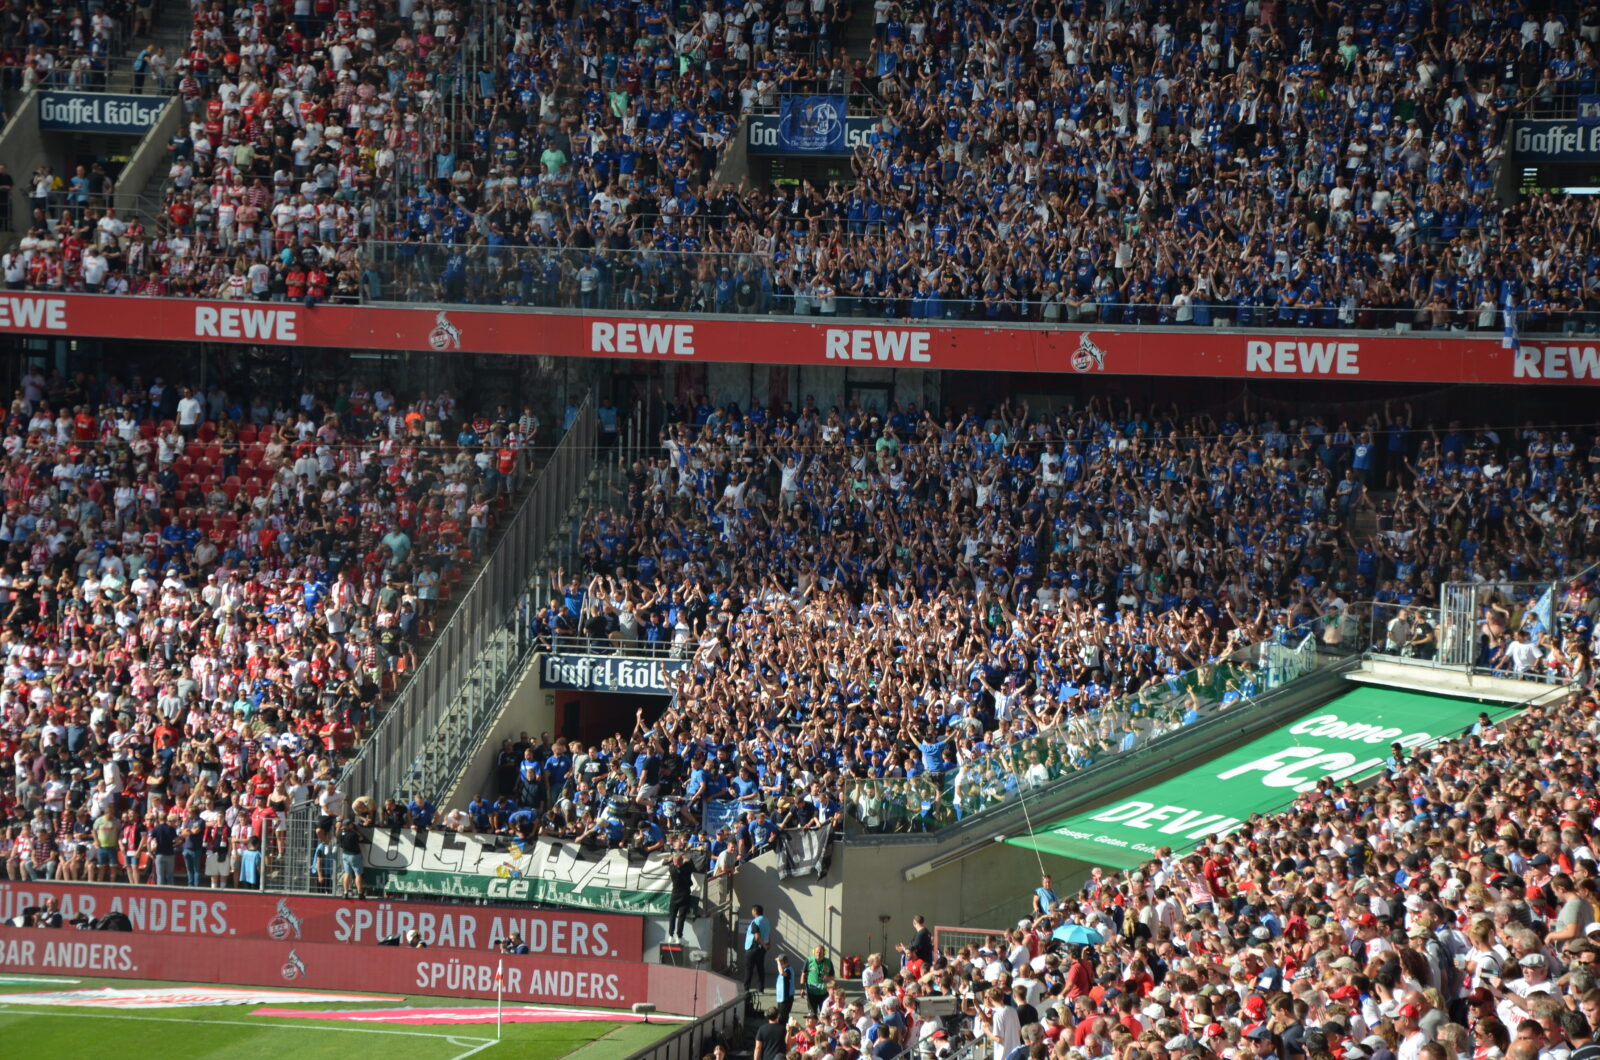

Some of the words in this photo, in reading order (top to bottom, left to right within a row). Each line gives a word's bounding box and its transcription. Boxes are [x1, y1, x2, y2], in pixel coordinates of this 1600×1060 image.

[41, 97, 101, 124] Gaffel
[1515, 126, 1586, 154] Gaffel
[195, 306, 297, 341] REWE
[591, 321, 694, 355] REWE
[826, 329, 931, 362] REWE
[1246, 341, 1359, 375] REWE
[545, 656, 612, 688] Gaffel
[1289, 714, 1402, 744] Come
[368, 827, 674, 893] ULTRAS
[334, 903, 476, 949] SPÜRBAR
[488, 917, 618, 957] ANDERS.
[42, 941, 138, 971] ANDERS.
[529, 969, 624, 1000] ANDERS.
